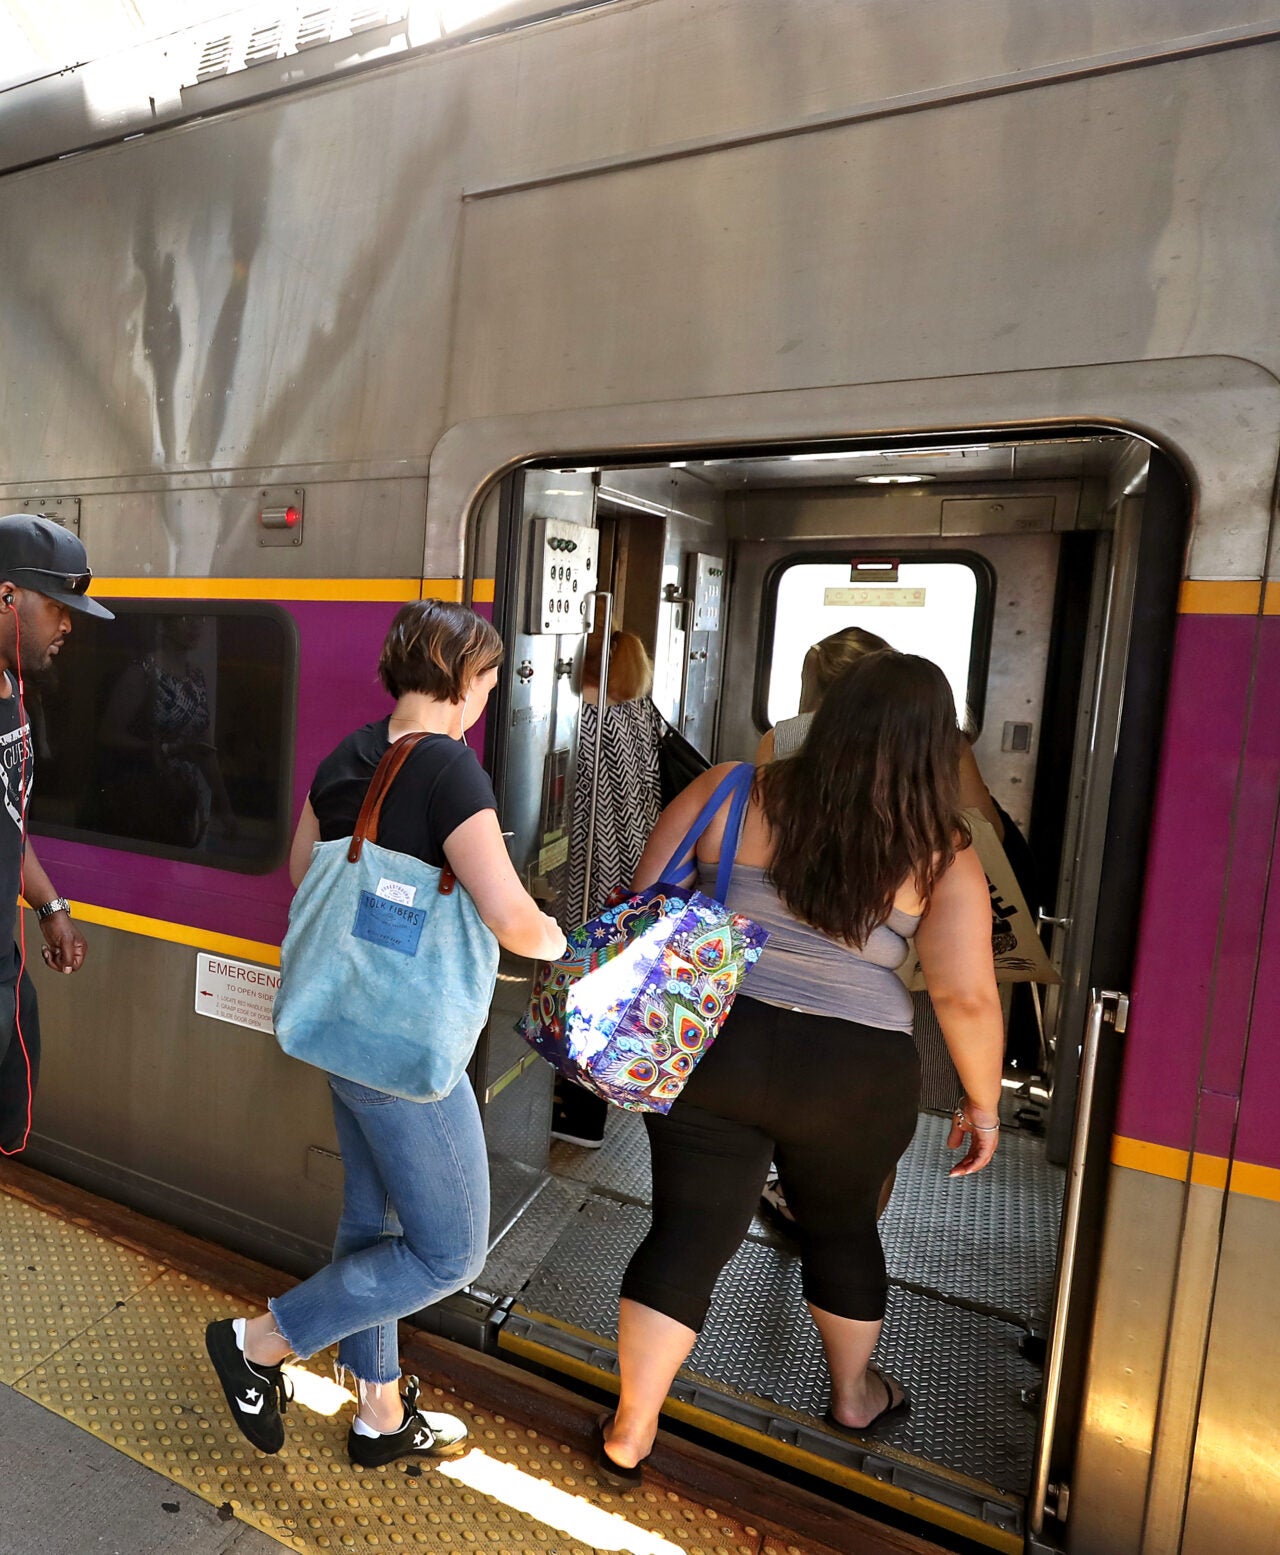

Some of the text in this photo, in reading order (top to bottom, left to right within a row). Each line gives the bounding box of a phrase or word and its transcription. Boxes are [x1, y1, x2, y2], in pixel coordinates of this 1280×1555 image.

[389, 904, 420, 926] FIBERS
[227, 984, 274, 1002] TO OPEN SIDE
